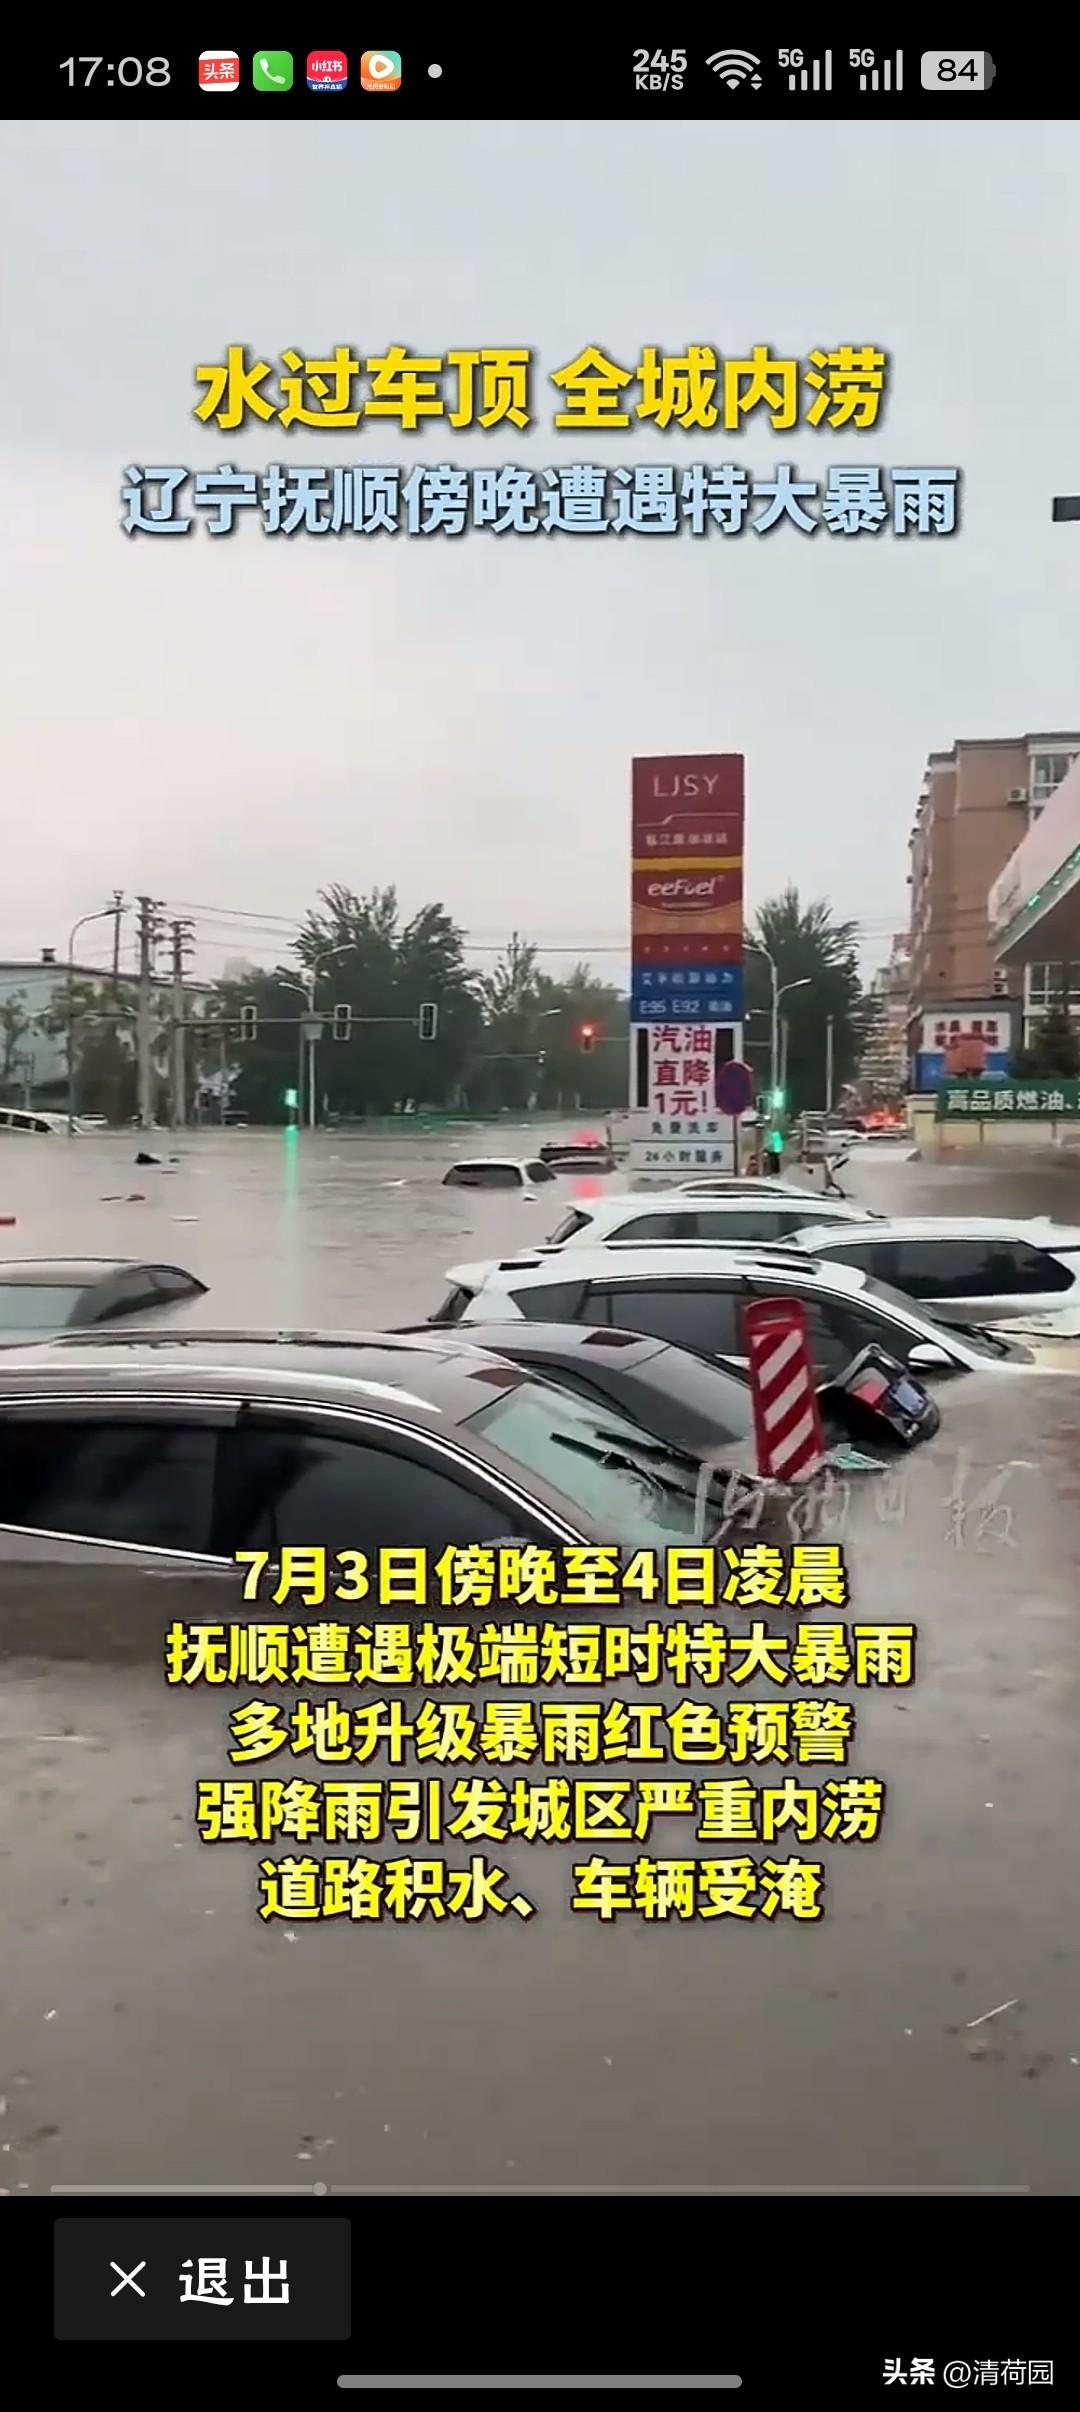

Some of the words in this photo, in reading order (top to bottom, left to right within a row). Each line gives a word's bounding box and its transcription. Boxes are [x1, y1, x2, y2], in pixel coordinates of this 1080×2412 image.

[311, 59, 343, 73] 小红书
[632, 49, 687, 73] 245
[778, 49, 804, 68] 5G
[849, 49, 875, 68] 5G
[937, 58, 978, 82] 84
[59, 56, 171, 87] 17:08
[204, 62, 235, 80] 头条
[635, 74, 684, 91] KB/S
[654, 774, 719, 797] LJSY
[653, 1025, 712, 1053] 汽油
[653, 1059, 711, 1086] 直降
[947, 1089, 1080, 1111] 高品质燃油、
[179, 2256, 289, 2306] 退出
